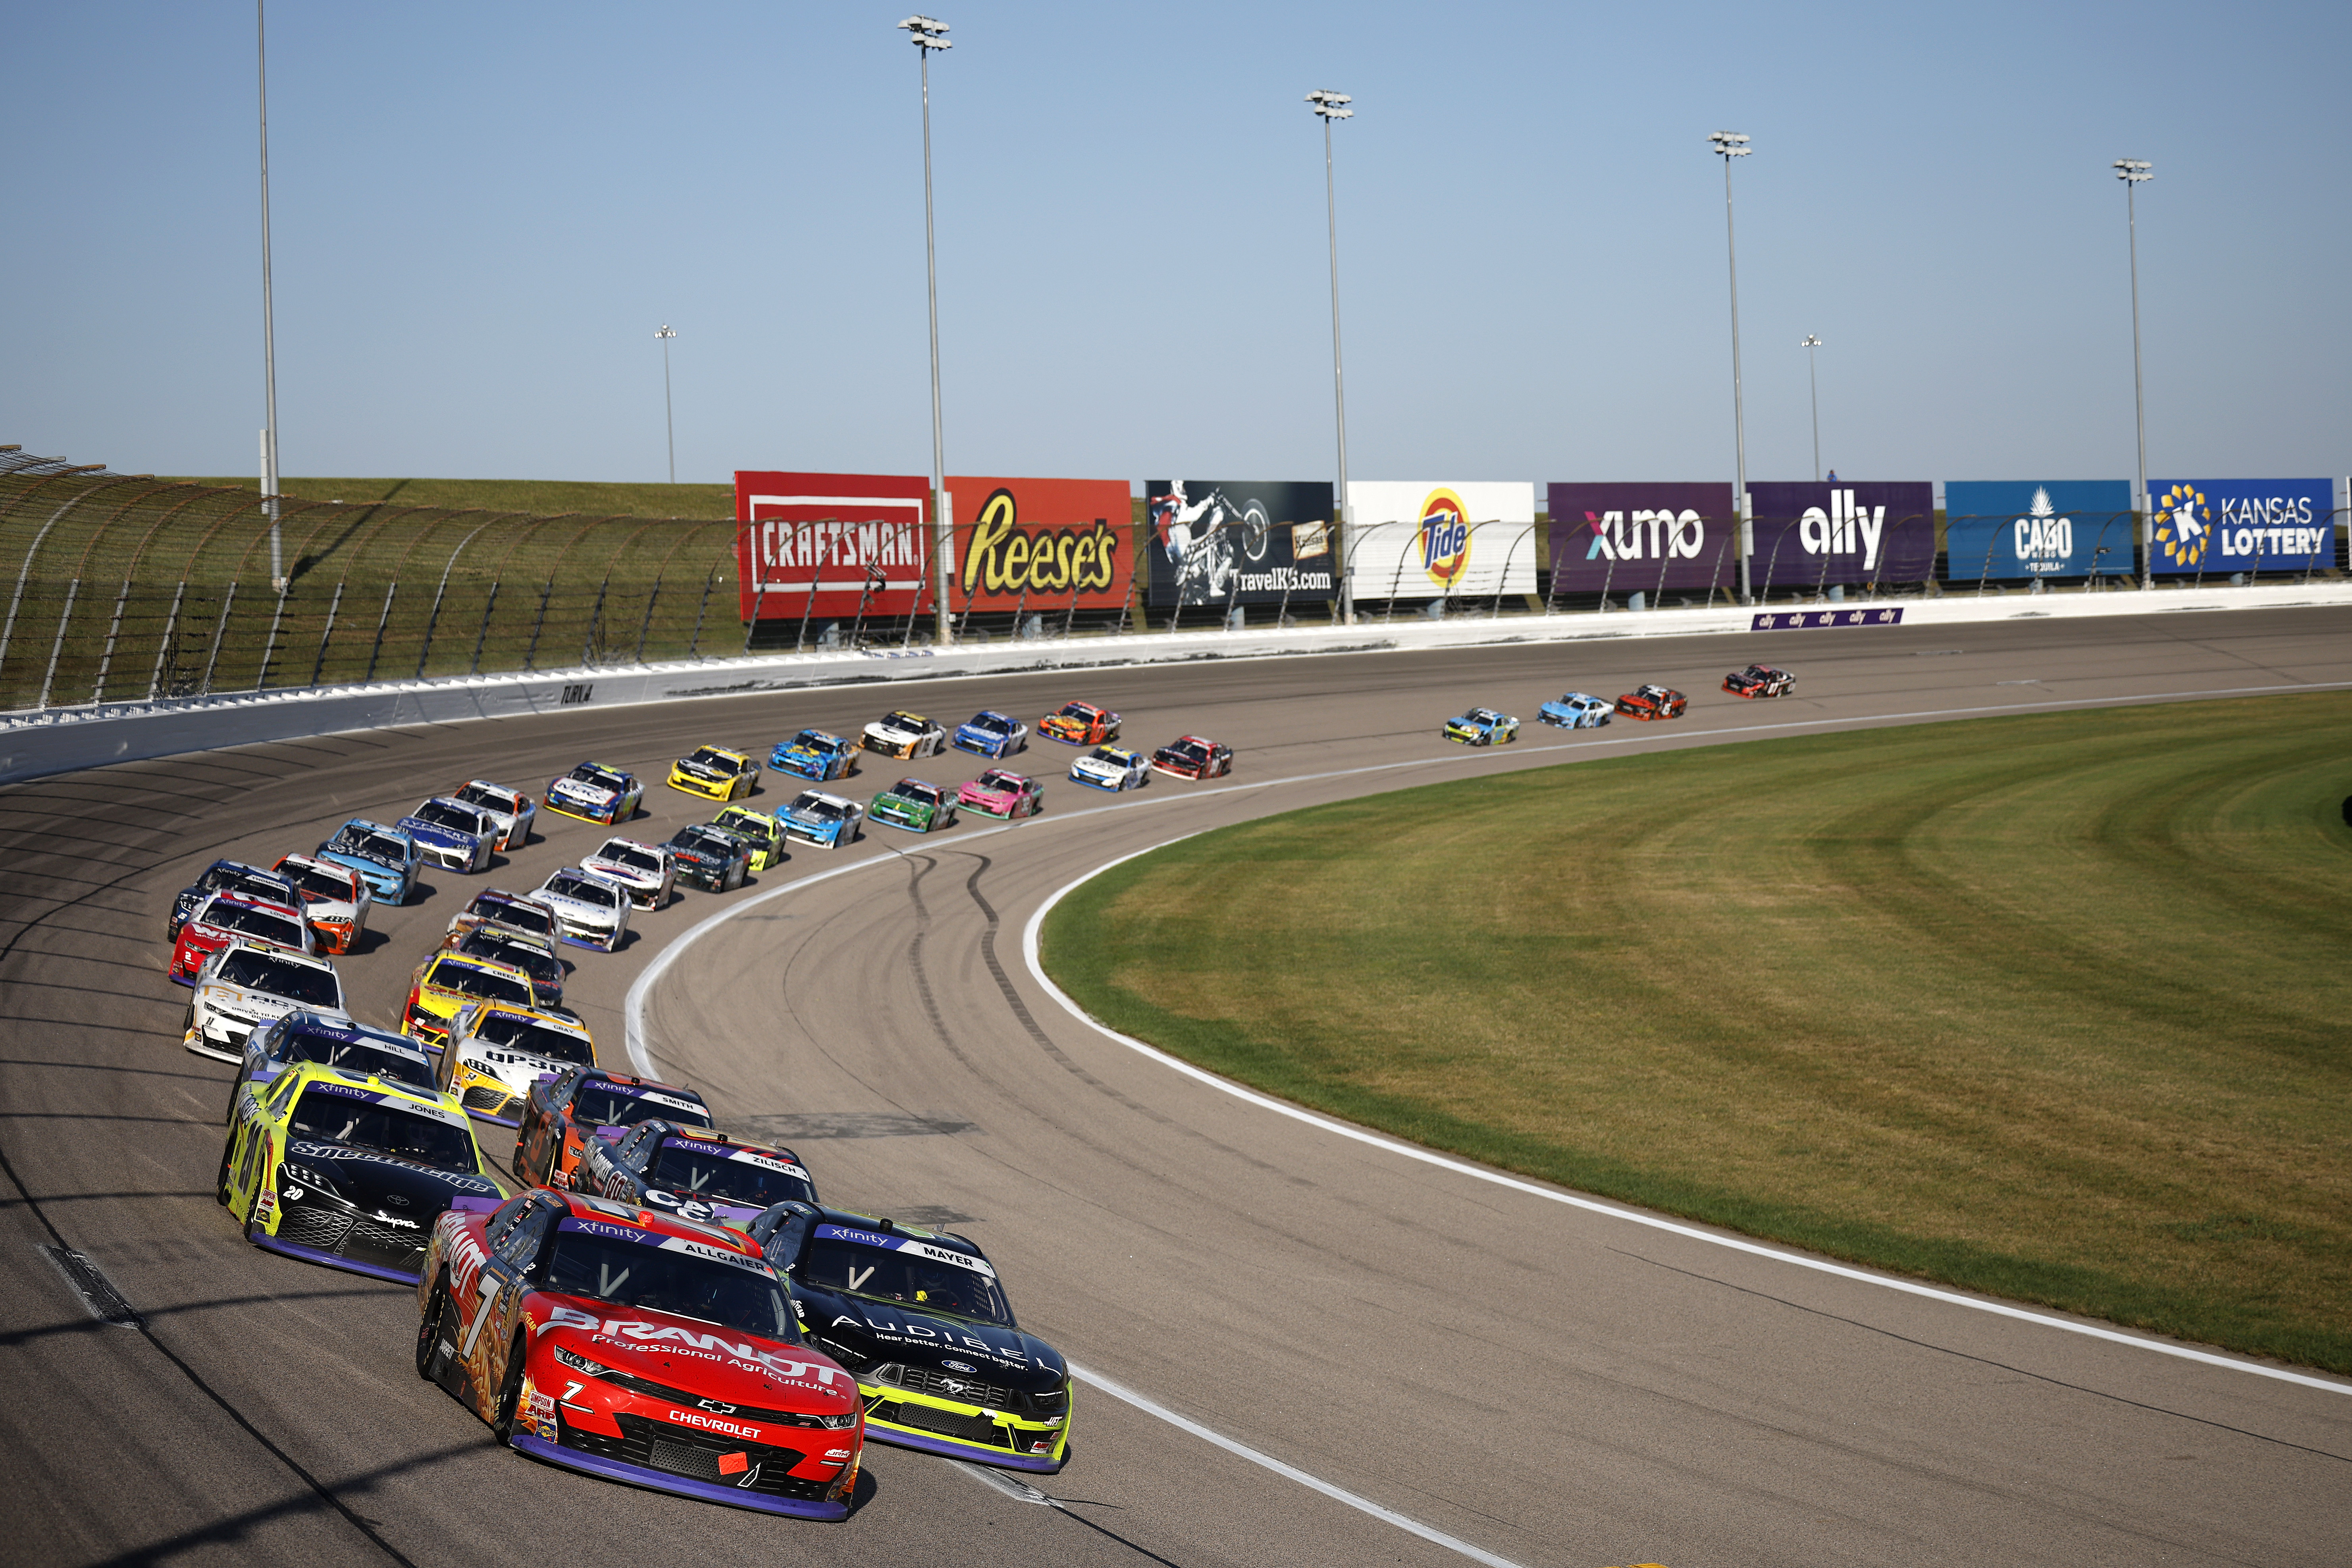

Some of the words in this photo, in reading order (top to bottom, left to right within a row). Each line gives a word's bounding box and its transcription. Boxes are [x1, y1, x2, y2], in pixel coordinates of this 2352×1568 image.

[2222, 497, 2312, 524] KANSAS
[1799, 489, 1886, 570] ally
[2171, 500, 2202, 542] K
[963, 491, 1116, 594] Reese's
[1422, 511, 1466, 569] Tide
[1584, 509, 1704, 560] xumo
[2015, 518, 2073, 559] CABO
[2222, 528, 2324, 555] LOTTERY
[763, 522, 912, 567] CRAFTSMAN
[1229, 567, 1331, 591] TravelKS.com
[1759, 614, 1776, 629] ally
[1789, 613, 1806, 627] ally
[1819, 612, 1836, 626] ally
[1849, 610, 1866, 624] ally
[1879, 609, 1896, 623] ally
[218, 868, 243, 877] xfinity
[252, 876, 289, 891] THOMPSON
[220, 898, 248, 908] xfinity
[185, 951, 192, 961] 2
[269, 955, 301, 969] xfinity
[447, 959, 476, 969] xfinity
[493, 970, 516, 980] CREED
[232, 1006, 259, 1016] DRIVEN
[495, 1011, 528, 1023] xfinity
[306, 1026, 349, 1040] xfinity
[553, 1024, 576, 1034] GRAY
[384, 1043, 405, 1055] HILL
[318, 1083, 370, 1099] xfinity
[595, 1081, 635, 1095] xfinity
[408, 1103, 445, 1119] JONES
[663, 1096, 693, 1110] SMITH
[675, 1138, 722, 1156] xfinity
[291, 1141, 493, 1192] Spectracide
[753, 1156, 796, 1174] ZILISCH
[283, 1185, 304, 1200] 20
[372, 1210, 420, 1229] Supra
[576, 1221, 646, 1242] xfinity
[831, 1227, 888, 1246] xfinity
[685, 1244, 766, 1273] ALLGAIER
[923, 1246, 973, 1267] MAYER
[460, 1269, 506, 1365] 7
[537, 1306, 855, 1385] BRANDT
[832, 1315, 1061, 1377] AUDIBEL
[876, 1333, 902, 1342] Hear
[905, 1337, 942, 1348] better.
[944, 1344, 990, 1360] Connect
[992, 1355, 1028, 1371] better.
[591, 1334, 722, 1362] Professional
[727, 1358, 838, 1396] Agriculture
[948, 1361, 971, 1372] Ford
[560, 1380, 586, 1401] 7
[530, 1393, 552, 1408] SIMPSON
[526, 1404, 555, 1420] ARP
[537, 1426, 555, 1437] SUNOCO
[669, 1410, 761, 1439] CHEVROLET
